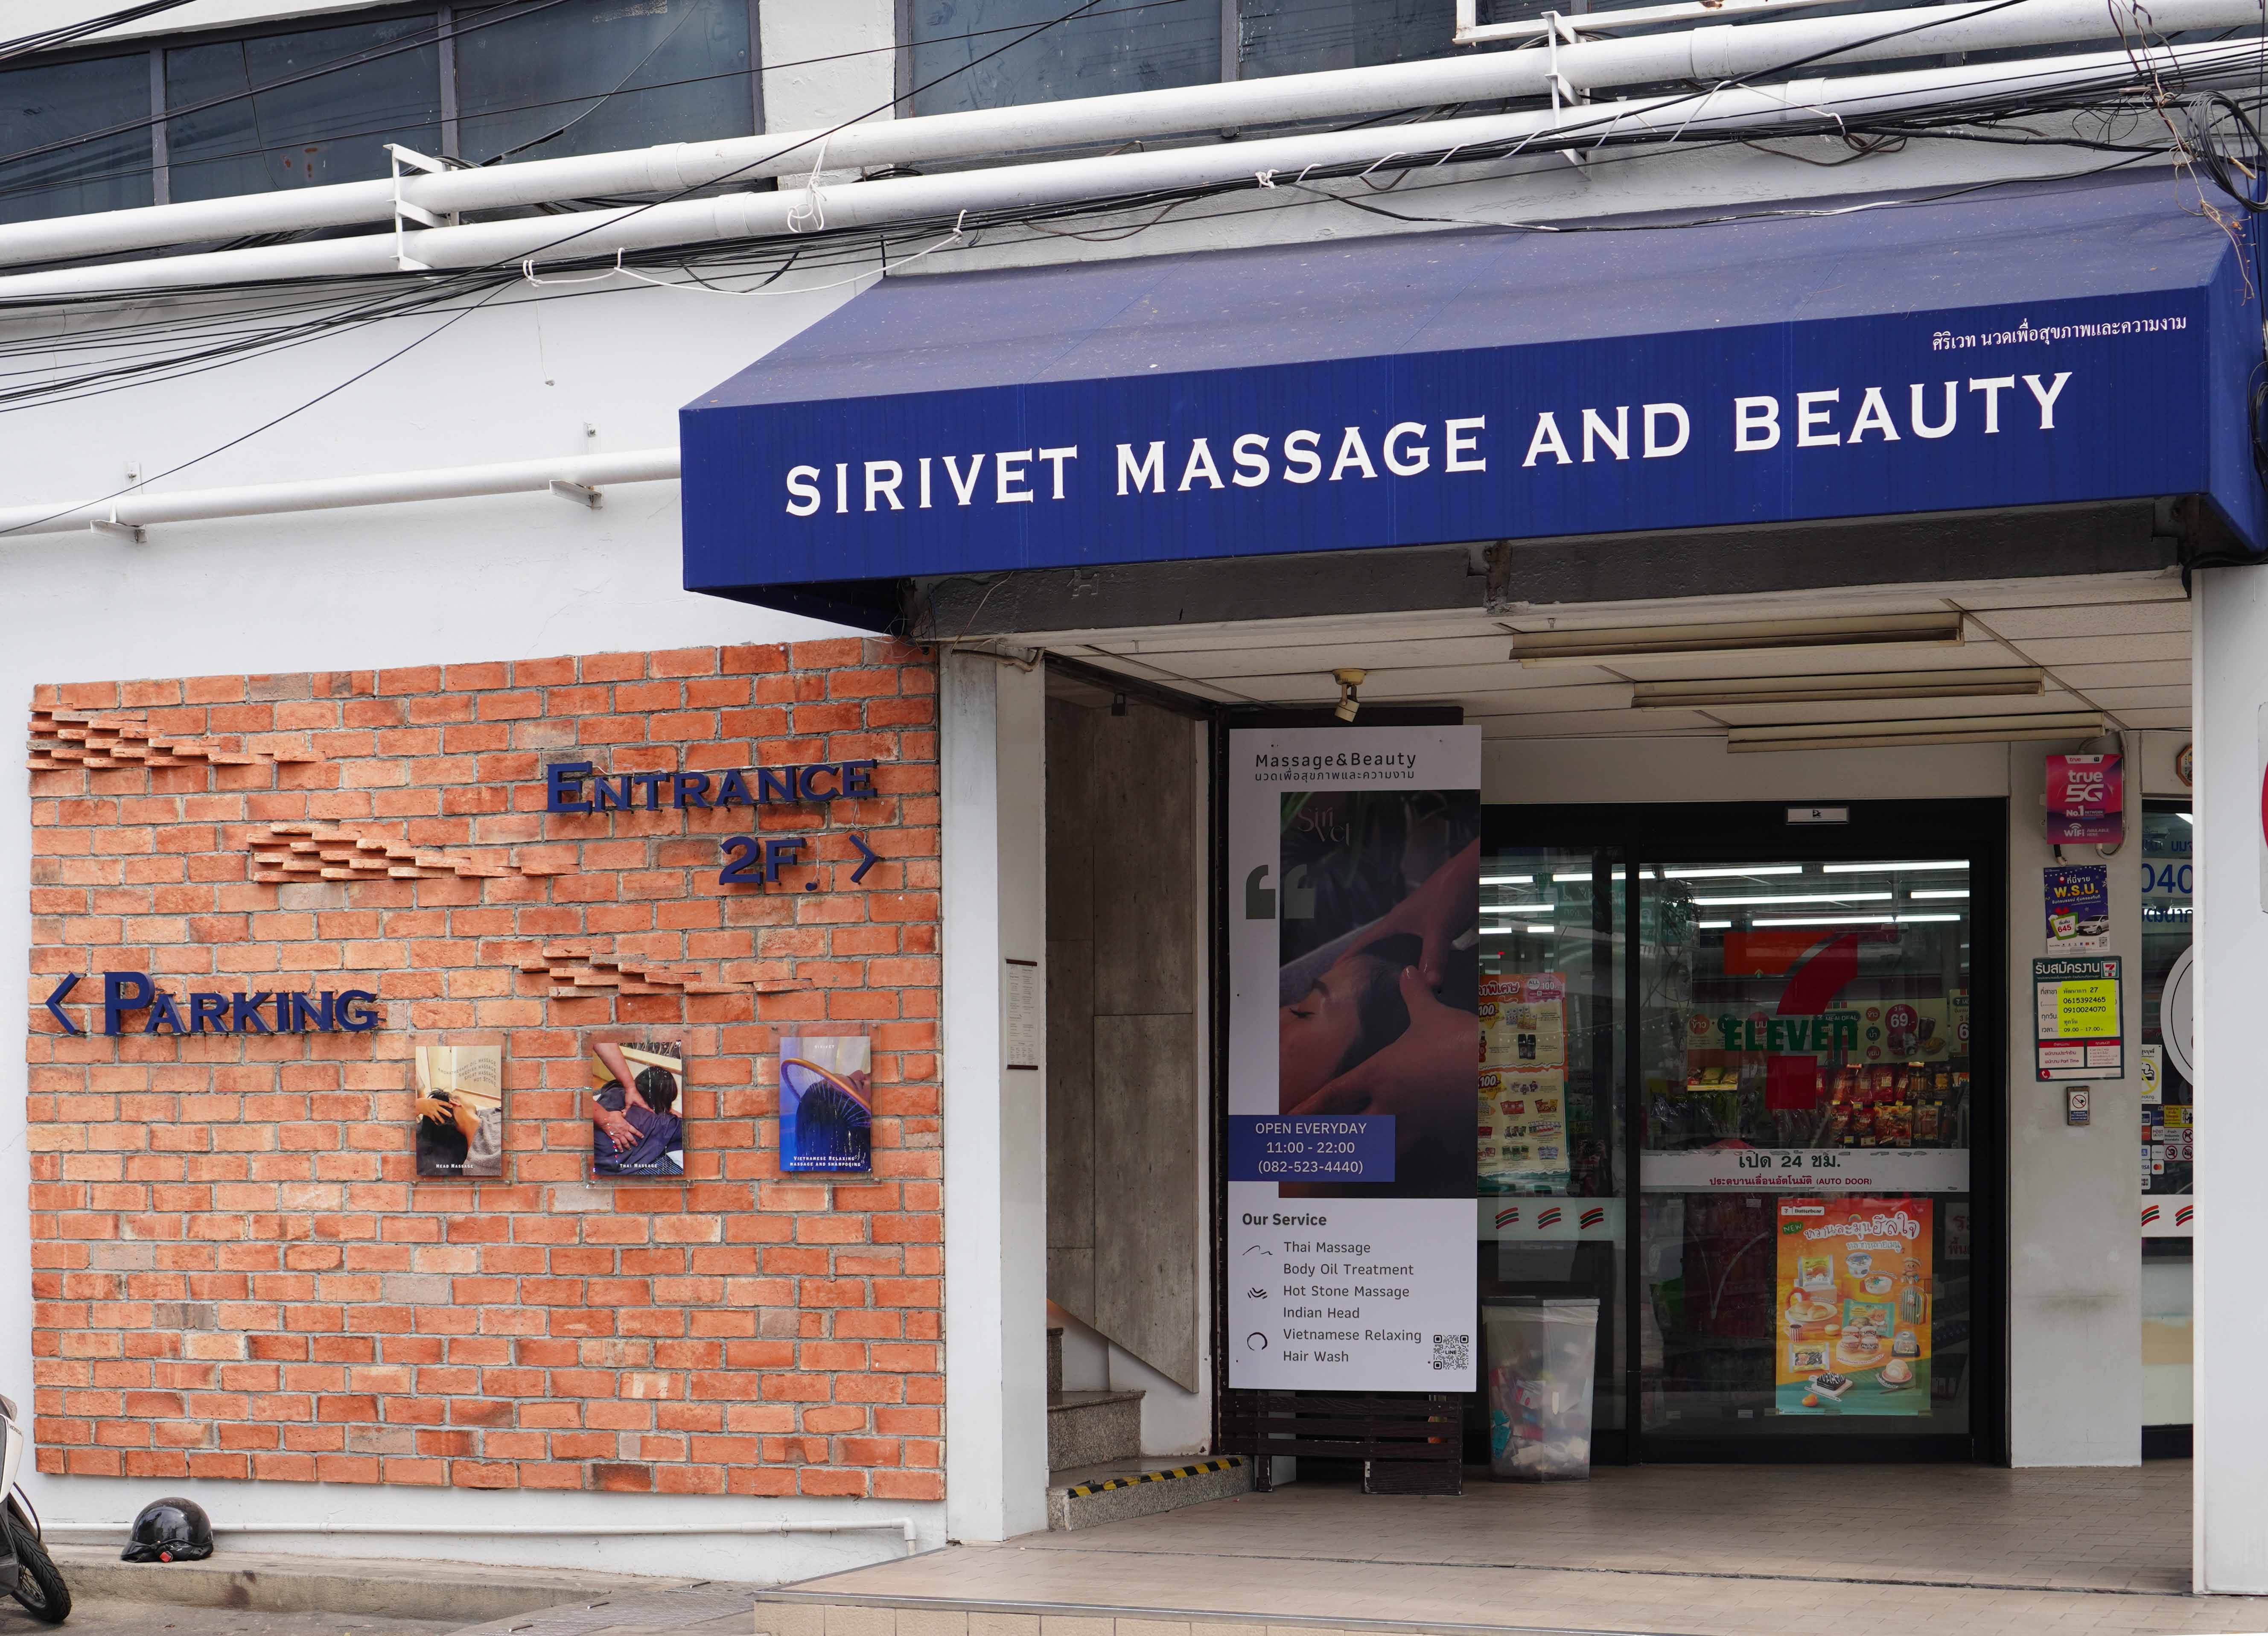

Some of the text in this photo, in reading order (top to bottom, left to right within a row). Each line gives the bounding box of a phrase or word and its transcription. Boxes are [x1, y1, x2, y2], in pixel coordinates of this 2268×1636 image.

[1933, 316, 2186, 350] ศิริเวท นวดเพื่อสุขภาพและความงาม
[785, 371, 2073, 516] SIRIVET MASSAGE AND BEAUTY
[1256, 752, 1417, 770] Massage&Beauty
[1255, 768, 1414, 783] นวดเพื่อสุขภาพและความงาม
[2067, 770, 2103, 783] true
[546, 759, 877, 814] ENTRANCE
[2064, 784, 2105, 802] 5G
[2066, 805, 2084, 817] No.1
[2035, 961, 2100, 974] รับสมัครงาน
[102, 971, 379, 1036] PARKING
[1255, 1123, 1367, 1134] OPEN EVERYDAY
[1266, 1142, 1304, 1153] 11:00
[1317, 1142, 1355, 1153] 22:00
[1739, 1149, 1771, 1168] เปิด
[1781, 1155, 1802, 1168] 24
[1258, 1160, 1363, 1175] (082-523-4440)
[1242, 1213, 1327, 1226] Our Service
[1783, 1223, 1802, 1233] NEW
[1283, 1241, 1371, 1256] Thai Massage
[1284, 1263, 1414, 1277] Body Oil Treatment
[1283, 1285, 1410, 1300] Hot Stone Massage
[1284, 1306, 1360, 1318] Indian Head
[1283, 1329, 1421, 1344] Vietnamese Relaxing
[1284, 1351, 1349, 1362] Hair Wash
